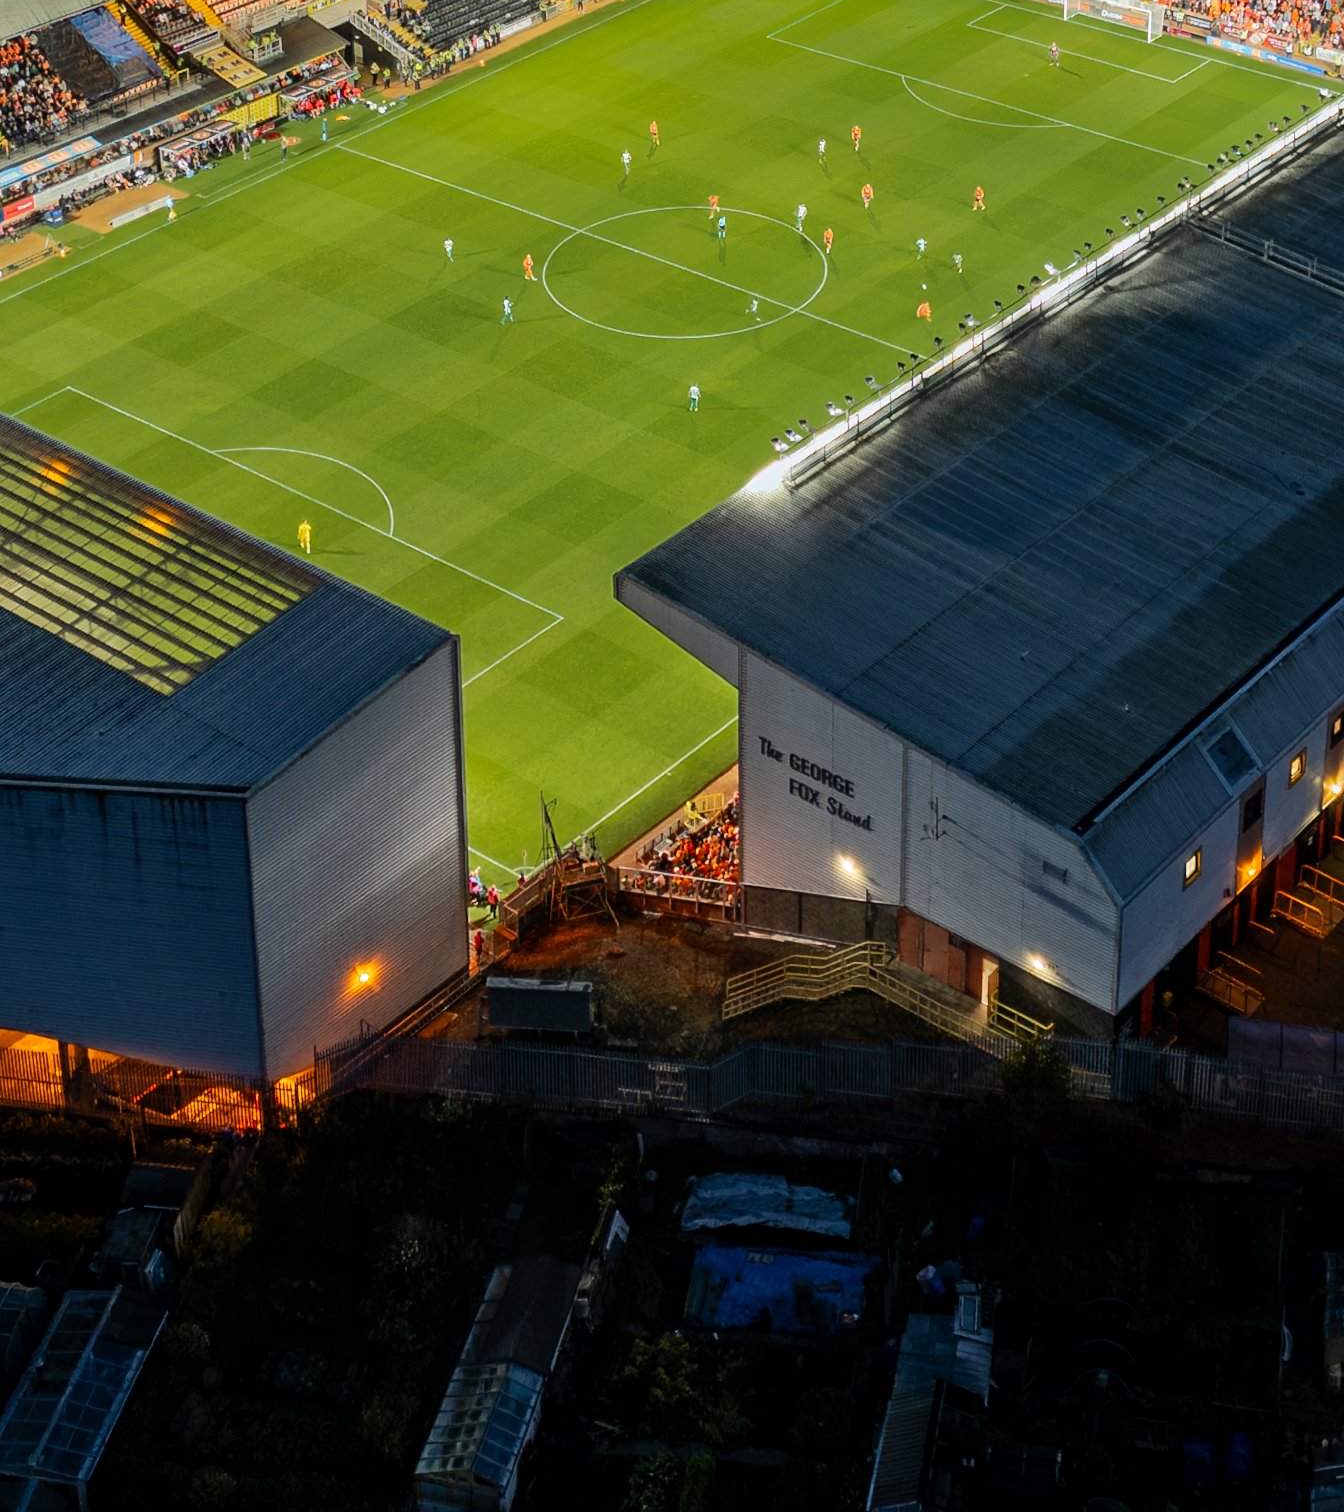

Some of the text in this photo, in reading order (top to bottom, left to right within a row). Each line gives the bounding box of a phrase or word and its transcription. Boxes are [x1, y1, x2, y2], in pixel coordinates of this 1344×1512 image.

[759, 736, 855, 799] The GEORGE
[788, 777, 873, 831] FOX Stand
